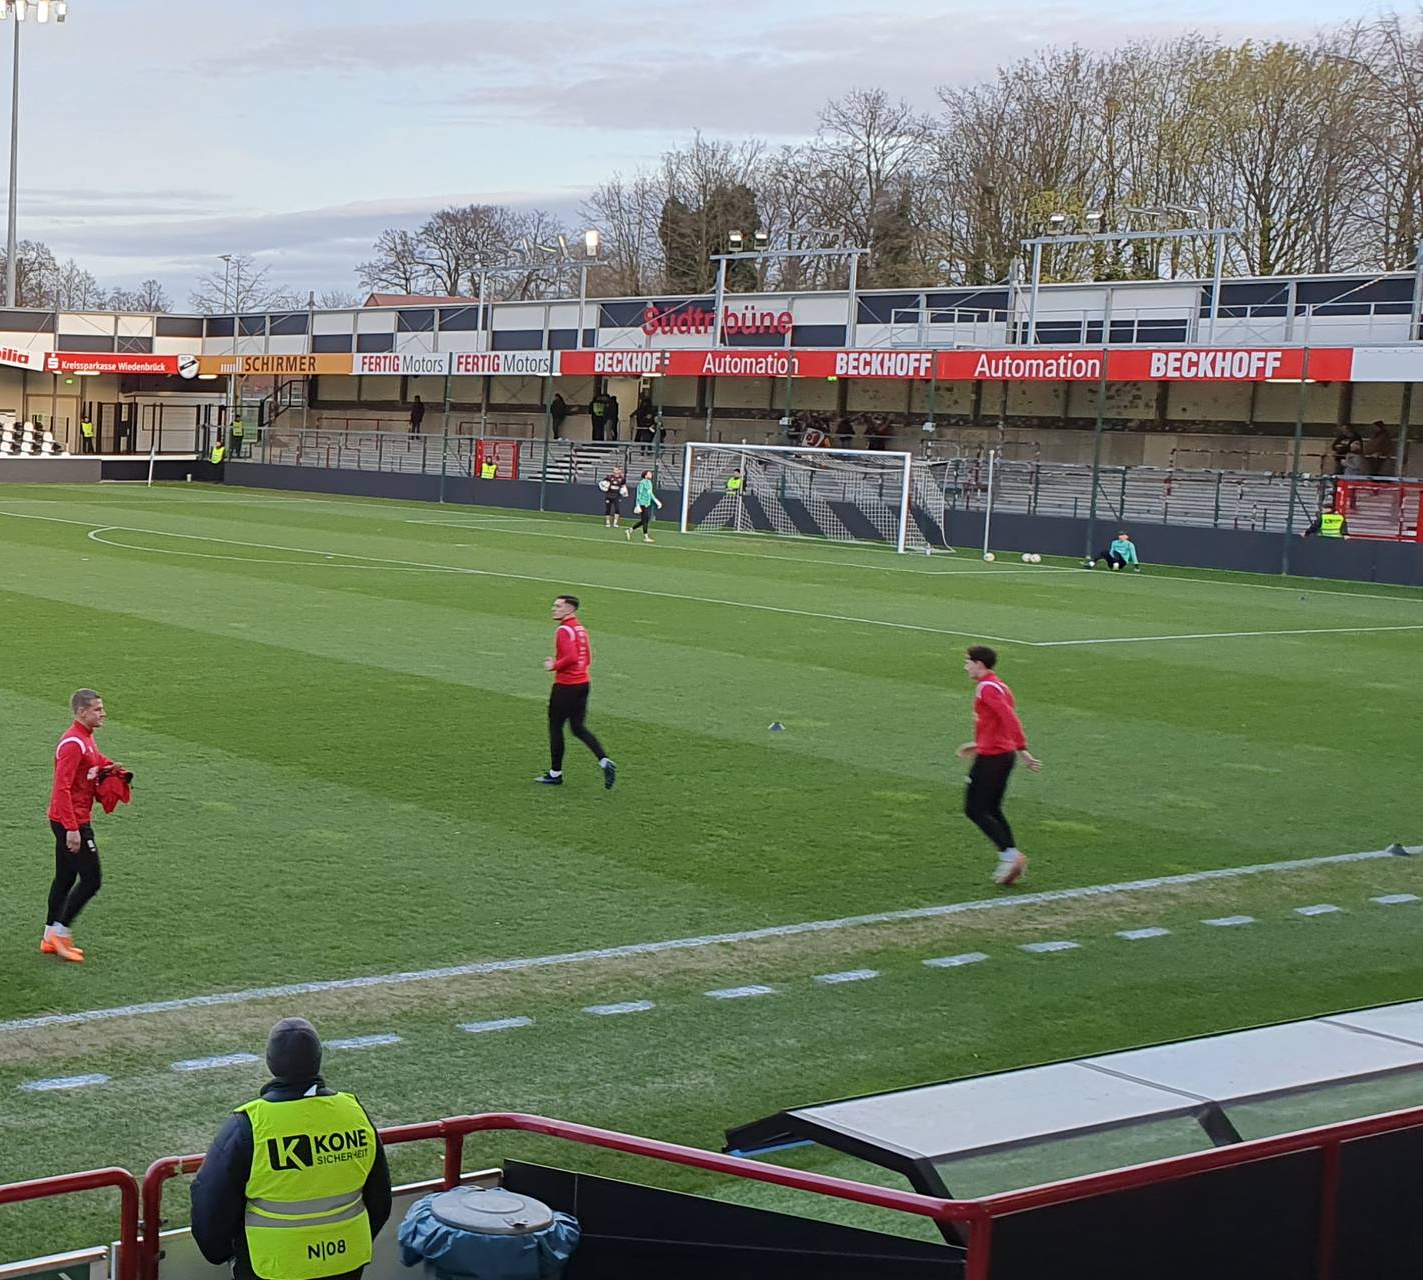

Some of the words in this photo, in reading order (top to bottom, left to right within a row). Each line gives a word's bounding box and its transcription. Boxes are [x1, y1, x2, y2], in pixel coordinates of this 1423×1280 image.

[641, 304, 794, 336] Südtrbüne
[61, 360, 116, 371] Kreissparkasse
[118, 362, 166, 372] Wiedenbrück
[244, 356, 317, 372] SCHIRMER
[362, 355, 400, 373] FERTIG
[402, 355, 444, 373] Motors
[457, 354, 500, 373] FERTIG
[503, 354, 550, 373] Motors
[702, 352, 799, 374] Automation
[835, 352, 932, 376] BECKHOFF
[974, 352, 1100, 378] Automation
[1149, 351, 1282, 378] BECKHOFF
[313, 1128, 368, 1154] KONE
